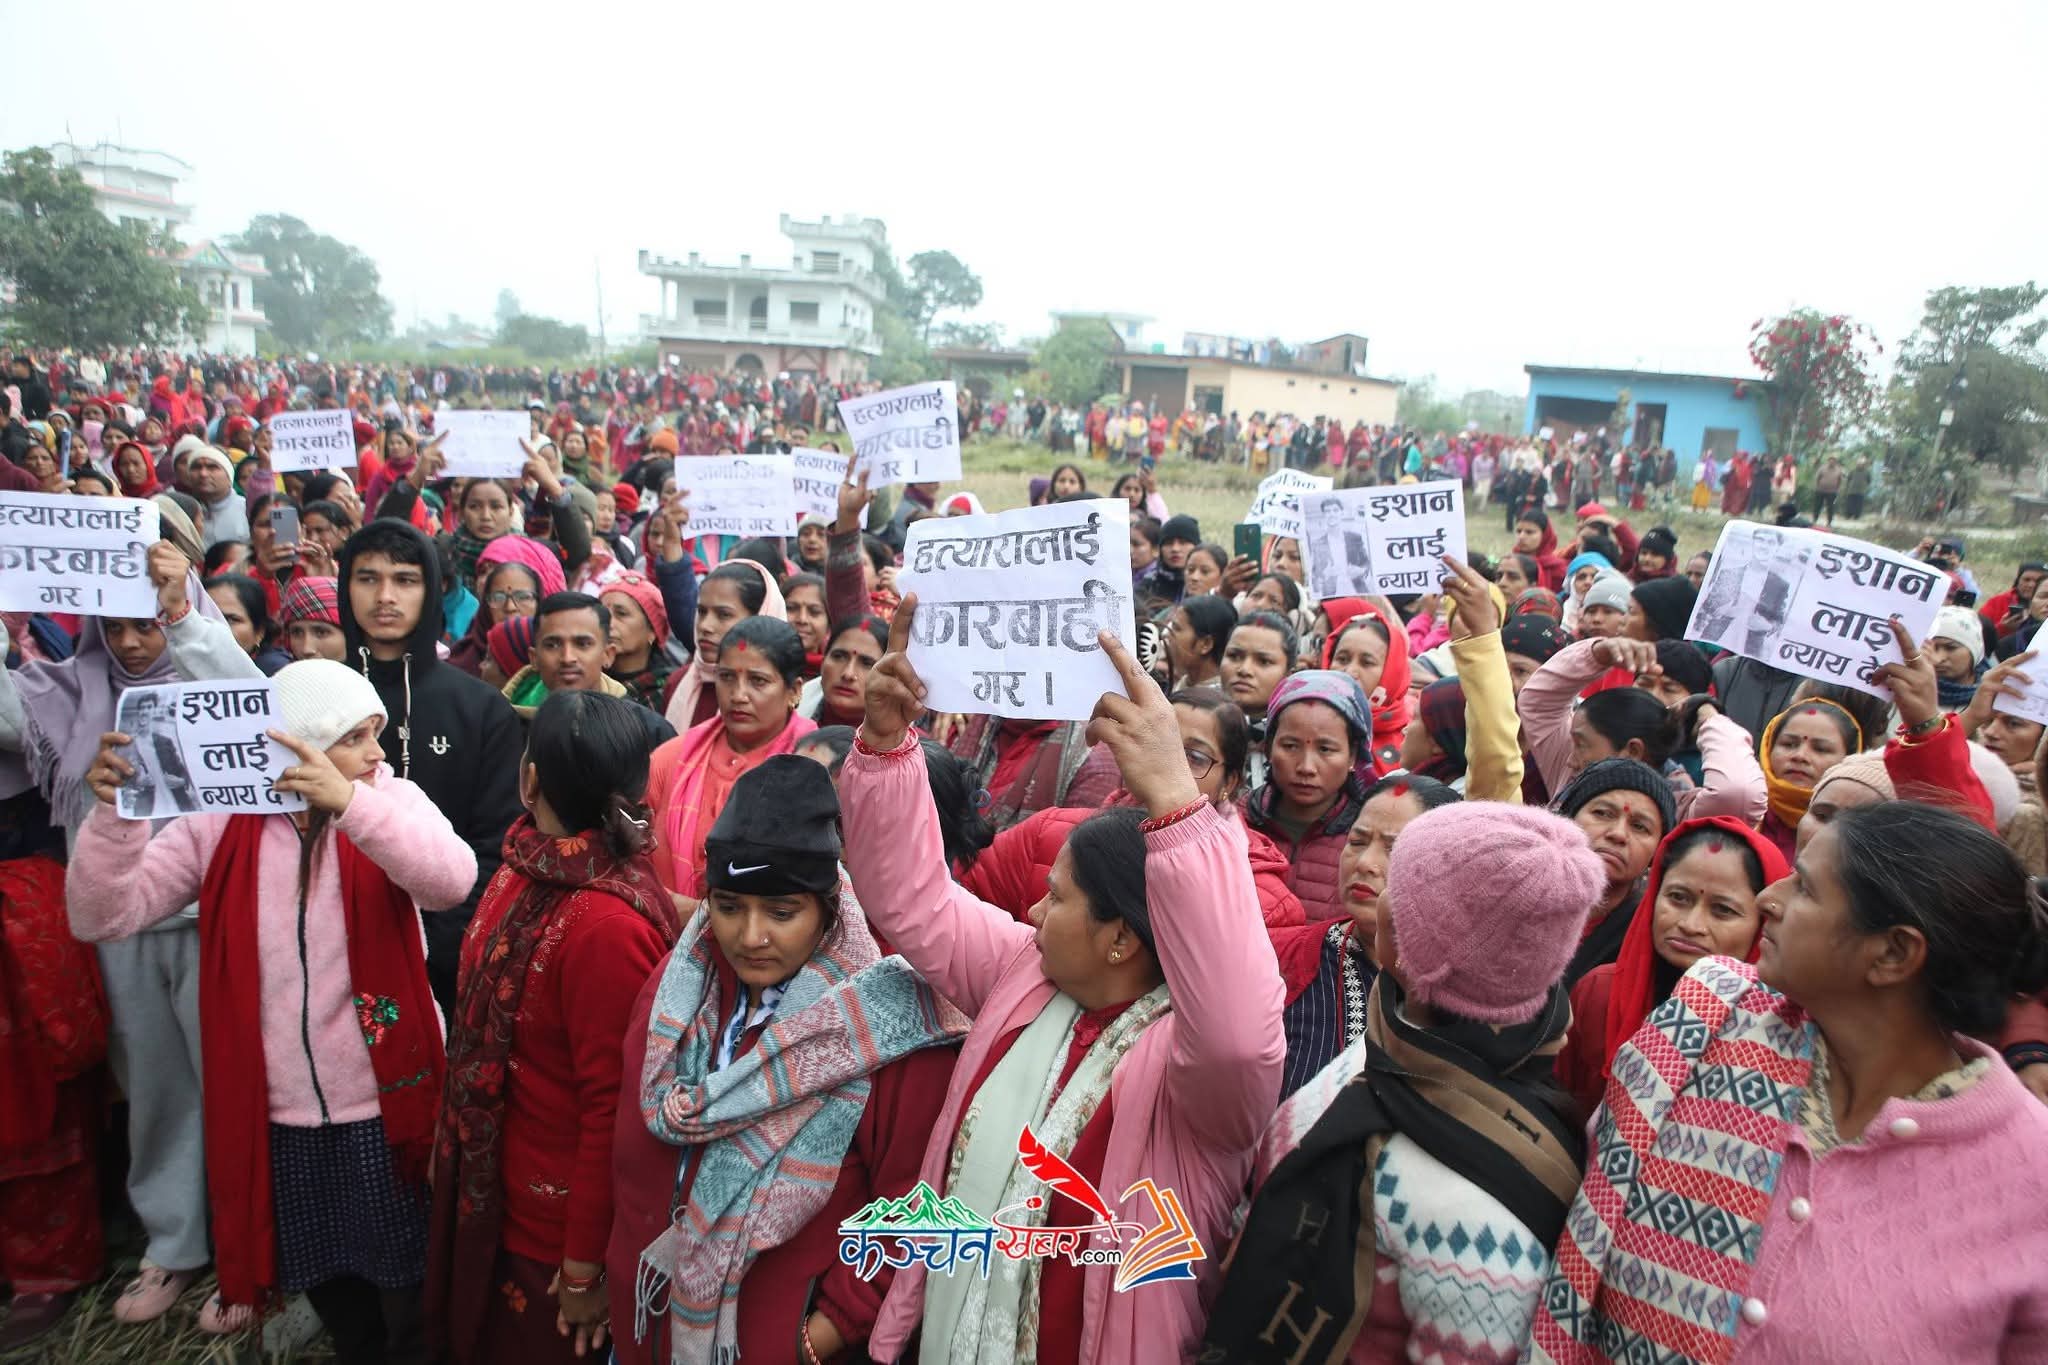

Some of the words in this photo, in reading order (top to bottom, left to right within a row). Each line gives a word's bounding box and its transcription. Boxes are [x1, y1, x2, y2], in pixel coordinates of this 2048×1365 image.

[852, 387, 943, 424] हत्यारालाई
[856, 416, 955, 458] कारबाही
[1370, 489, 1455, 522] इशान
[913, 512, 1102, 573] हत्यारालाई
[1385, 528, 1447, 560] लाई
[1376, 571, 1428, 589] न्याय
[1815, 543, 1941, 603] इशान
[40, 586, 82, 607] गर
[911, 579, 1127, 653] कारबाही
[1811, 601, 1904, 652] लाई
[1779, 638, 1852, 676] न्याय
[182, 688, 271, 725] इशान
[972, 671, 1027, 707] गर
[199, 733, 269, 772] लाई
[199, 784, 257, 806] न्याय
